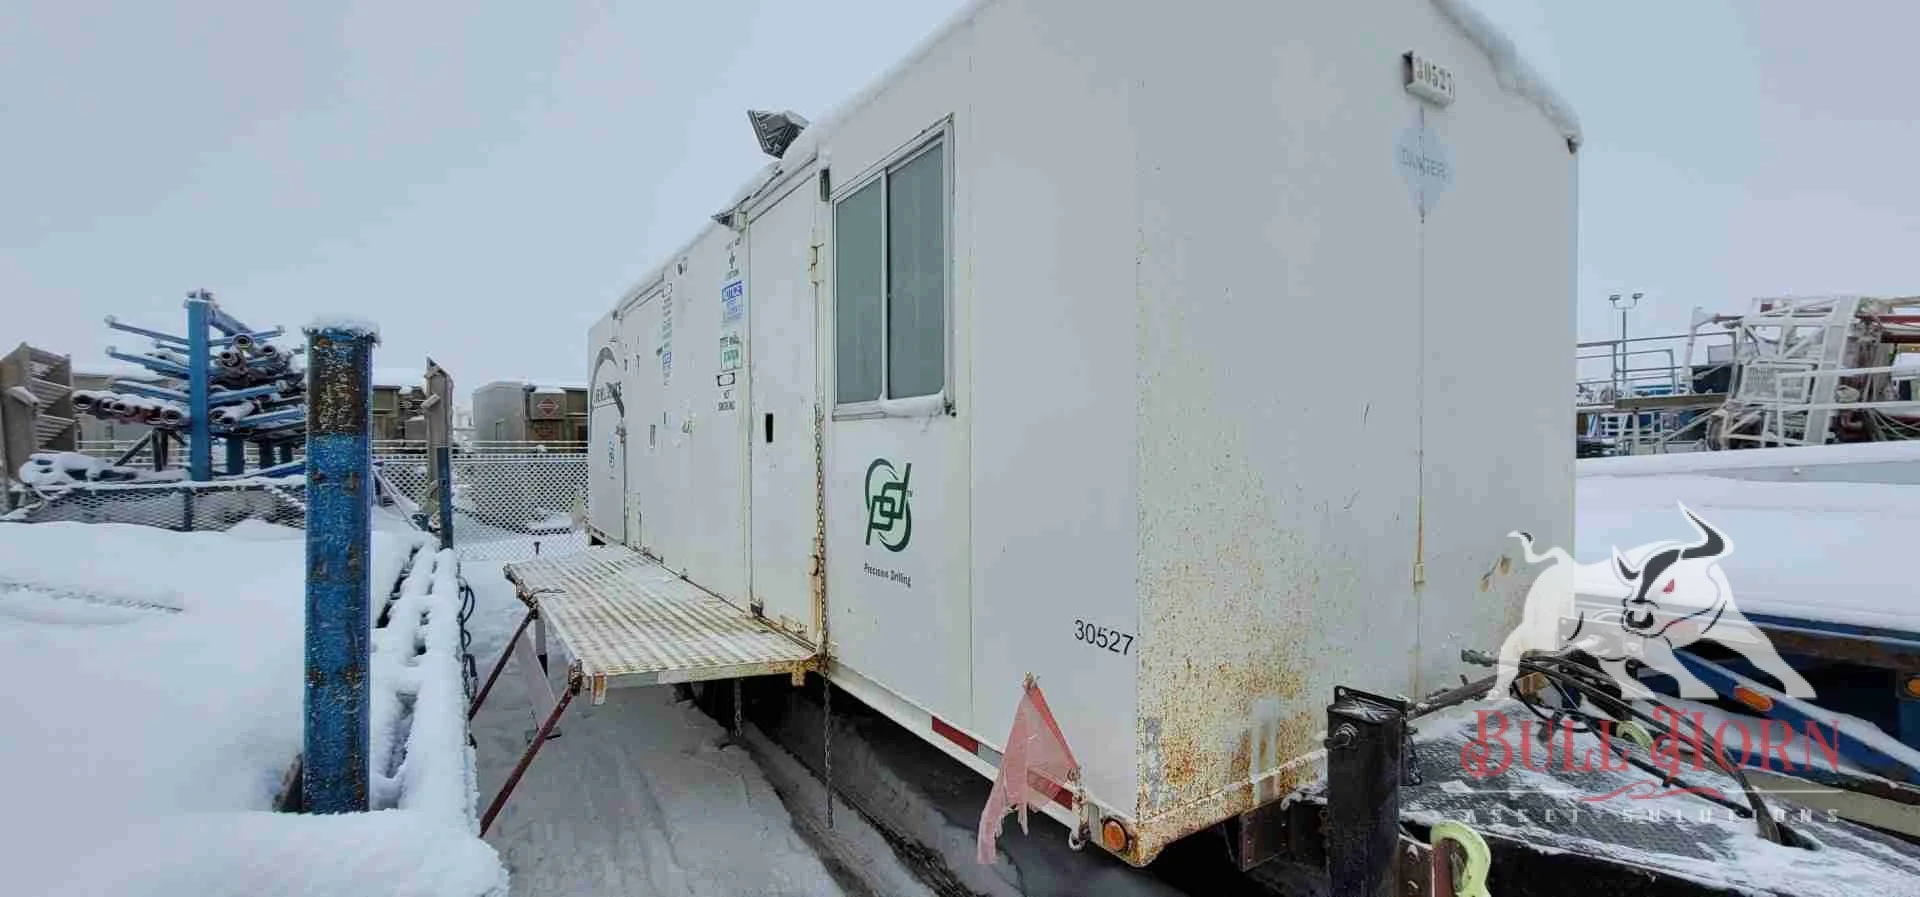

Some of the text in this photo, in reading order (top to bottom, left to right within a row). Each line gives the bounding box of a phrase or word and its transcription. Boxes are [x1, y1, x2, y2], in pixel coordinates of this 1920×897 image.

[1415, 56, 1454, 97] 30527
[1400, 148, 1448, 180] DANGER
[864, 560, 912, 588] Precision Drilling
[1074, 619, 1134, 656] 30527
